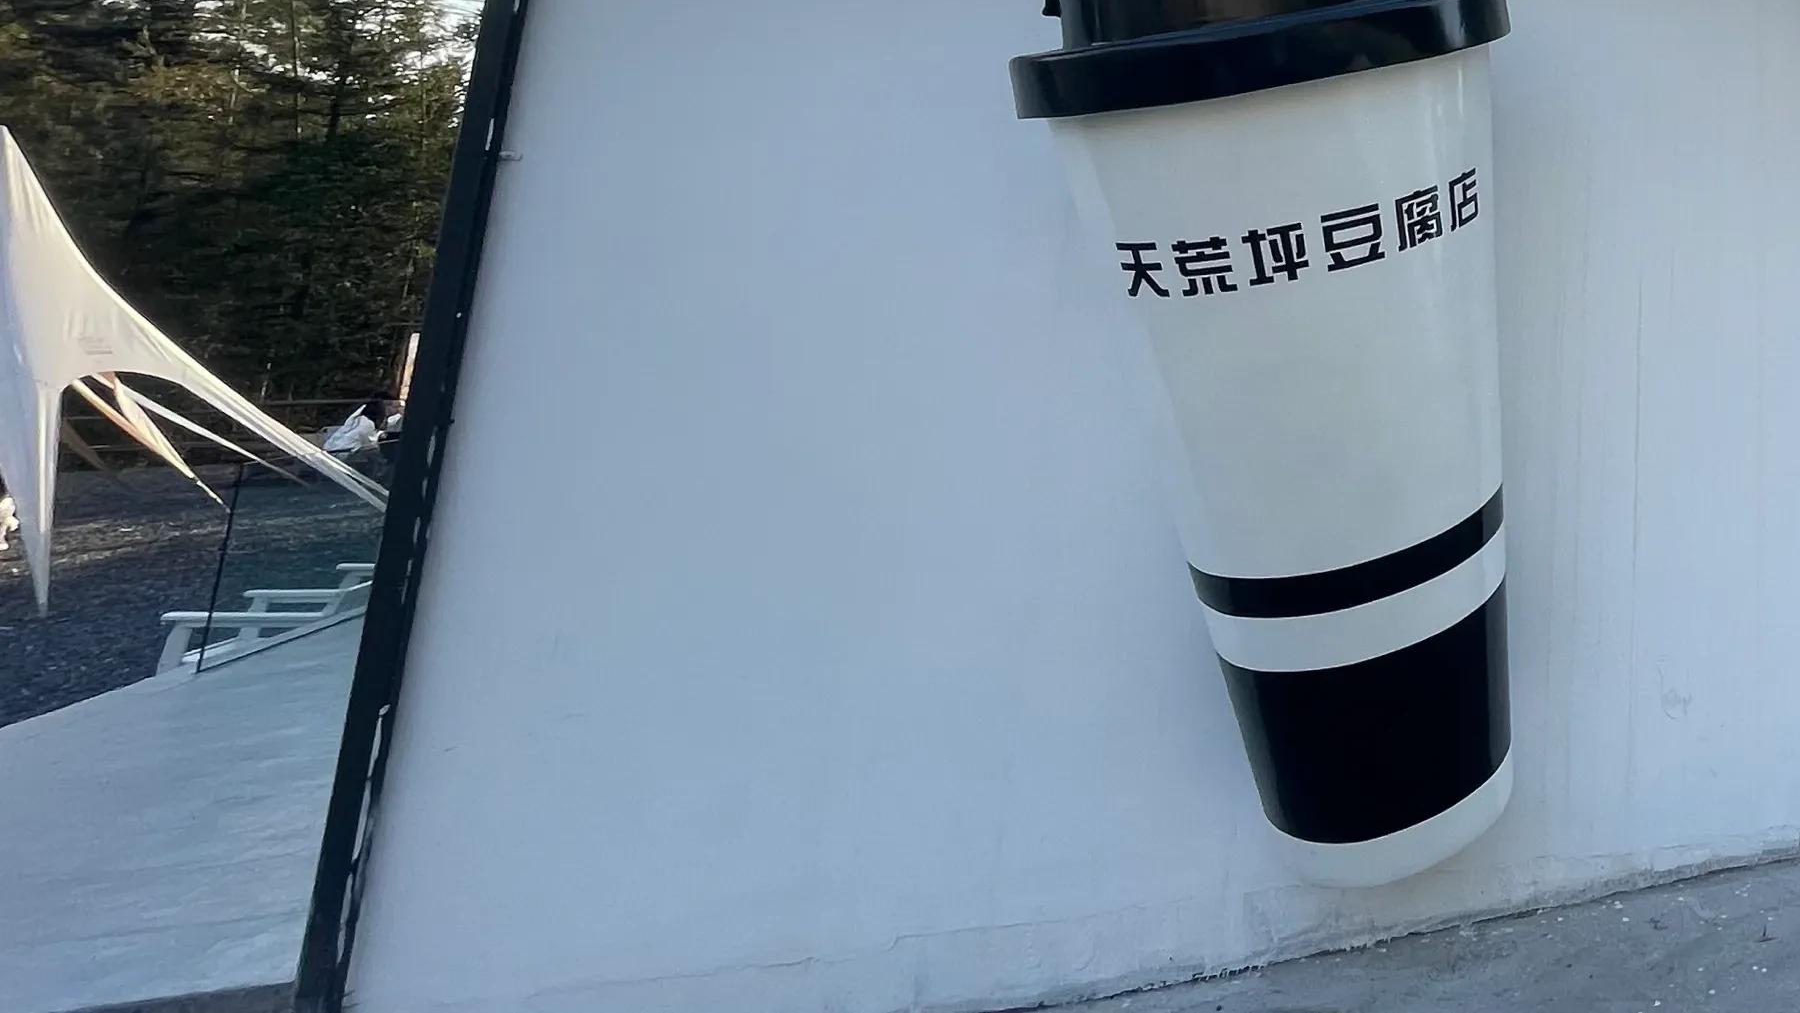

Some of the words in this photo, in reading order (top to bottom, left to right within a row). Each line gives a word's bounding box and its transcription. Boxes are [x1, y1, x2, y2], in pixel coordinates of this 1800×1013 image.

[1115, 167, 1480, 298] 天荒坪豆腐店
